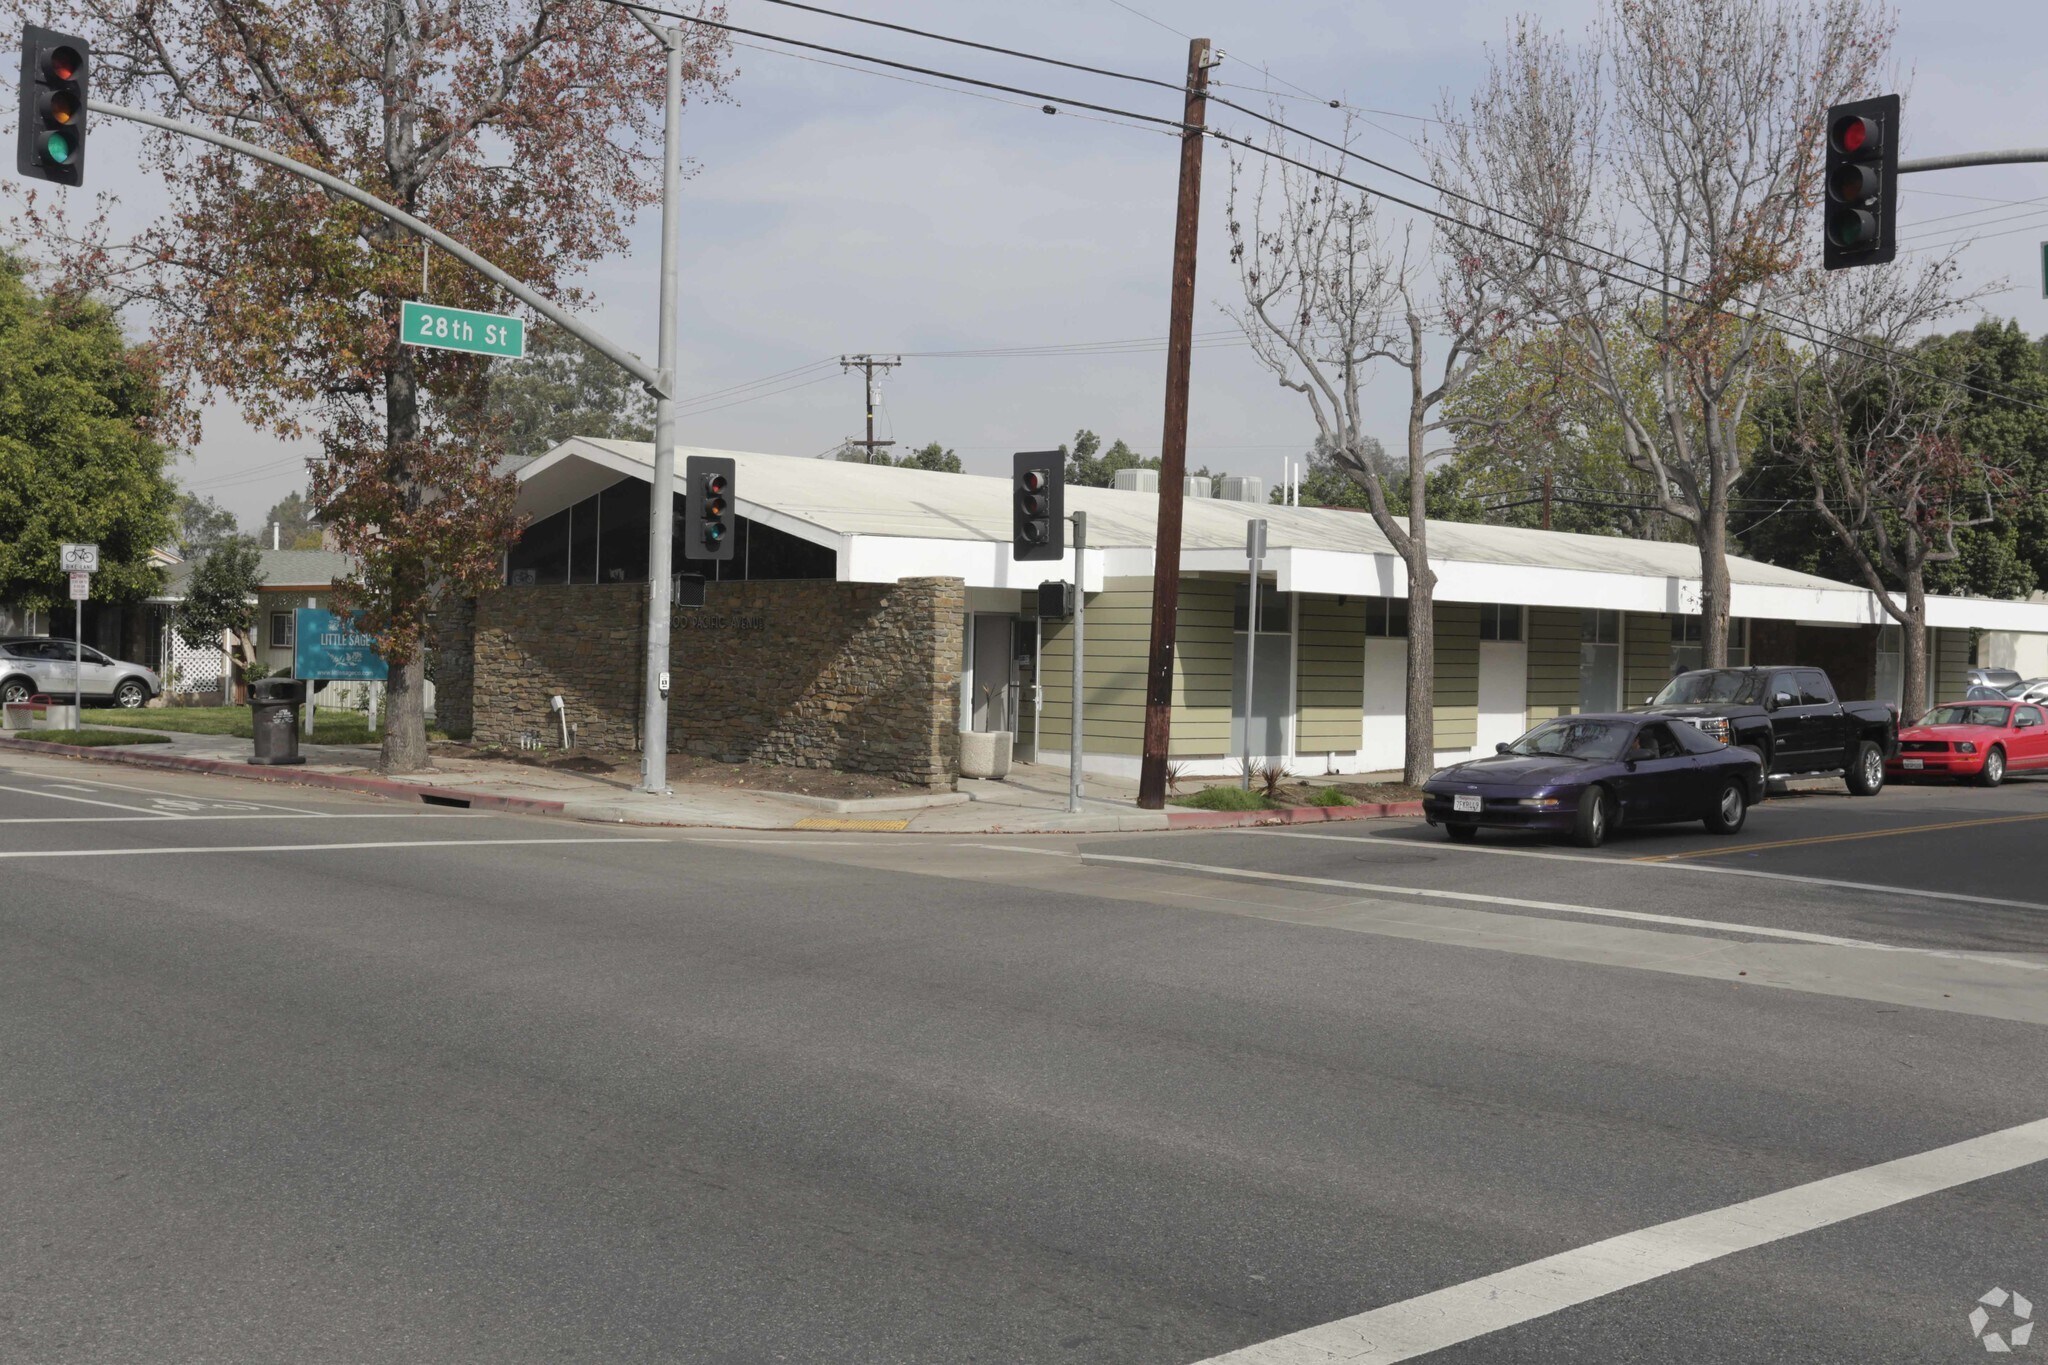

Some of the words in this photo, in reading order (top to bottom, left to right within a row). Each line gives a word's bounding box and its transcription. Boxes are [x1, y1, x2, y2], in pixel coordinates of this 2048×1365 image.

[420, 314, 473, 342] 28th
[484, 324, 508, 347] St
[693, 615, 726, 630] PACIFIC
[731, 616, 764, 630] AVENUE
[321, 634, 347, 646] LITTLE
[349, 634, 370, 647] SAGE
